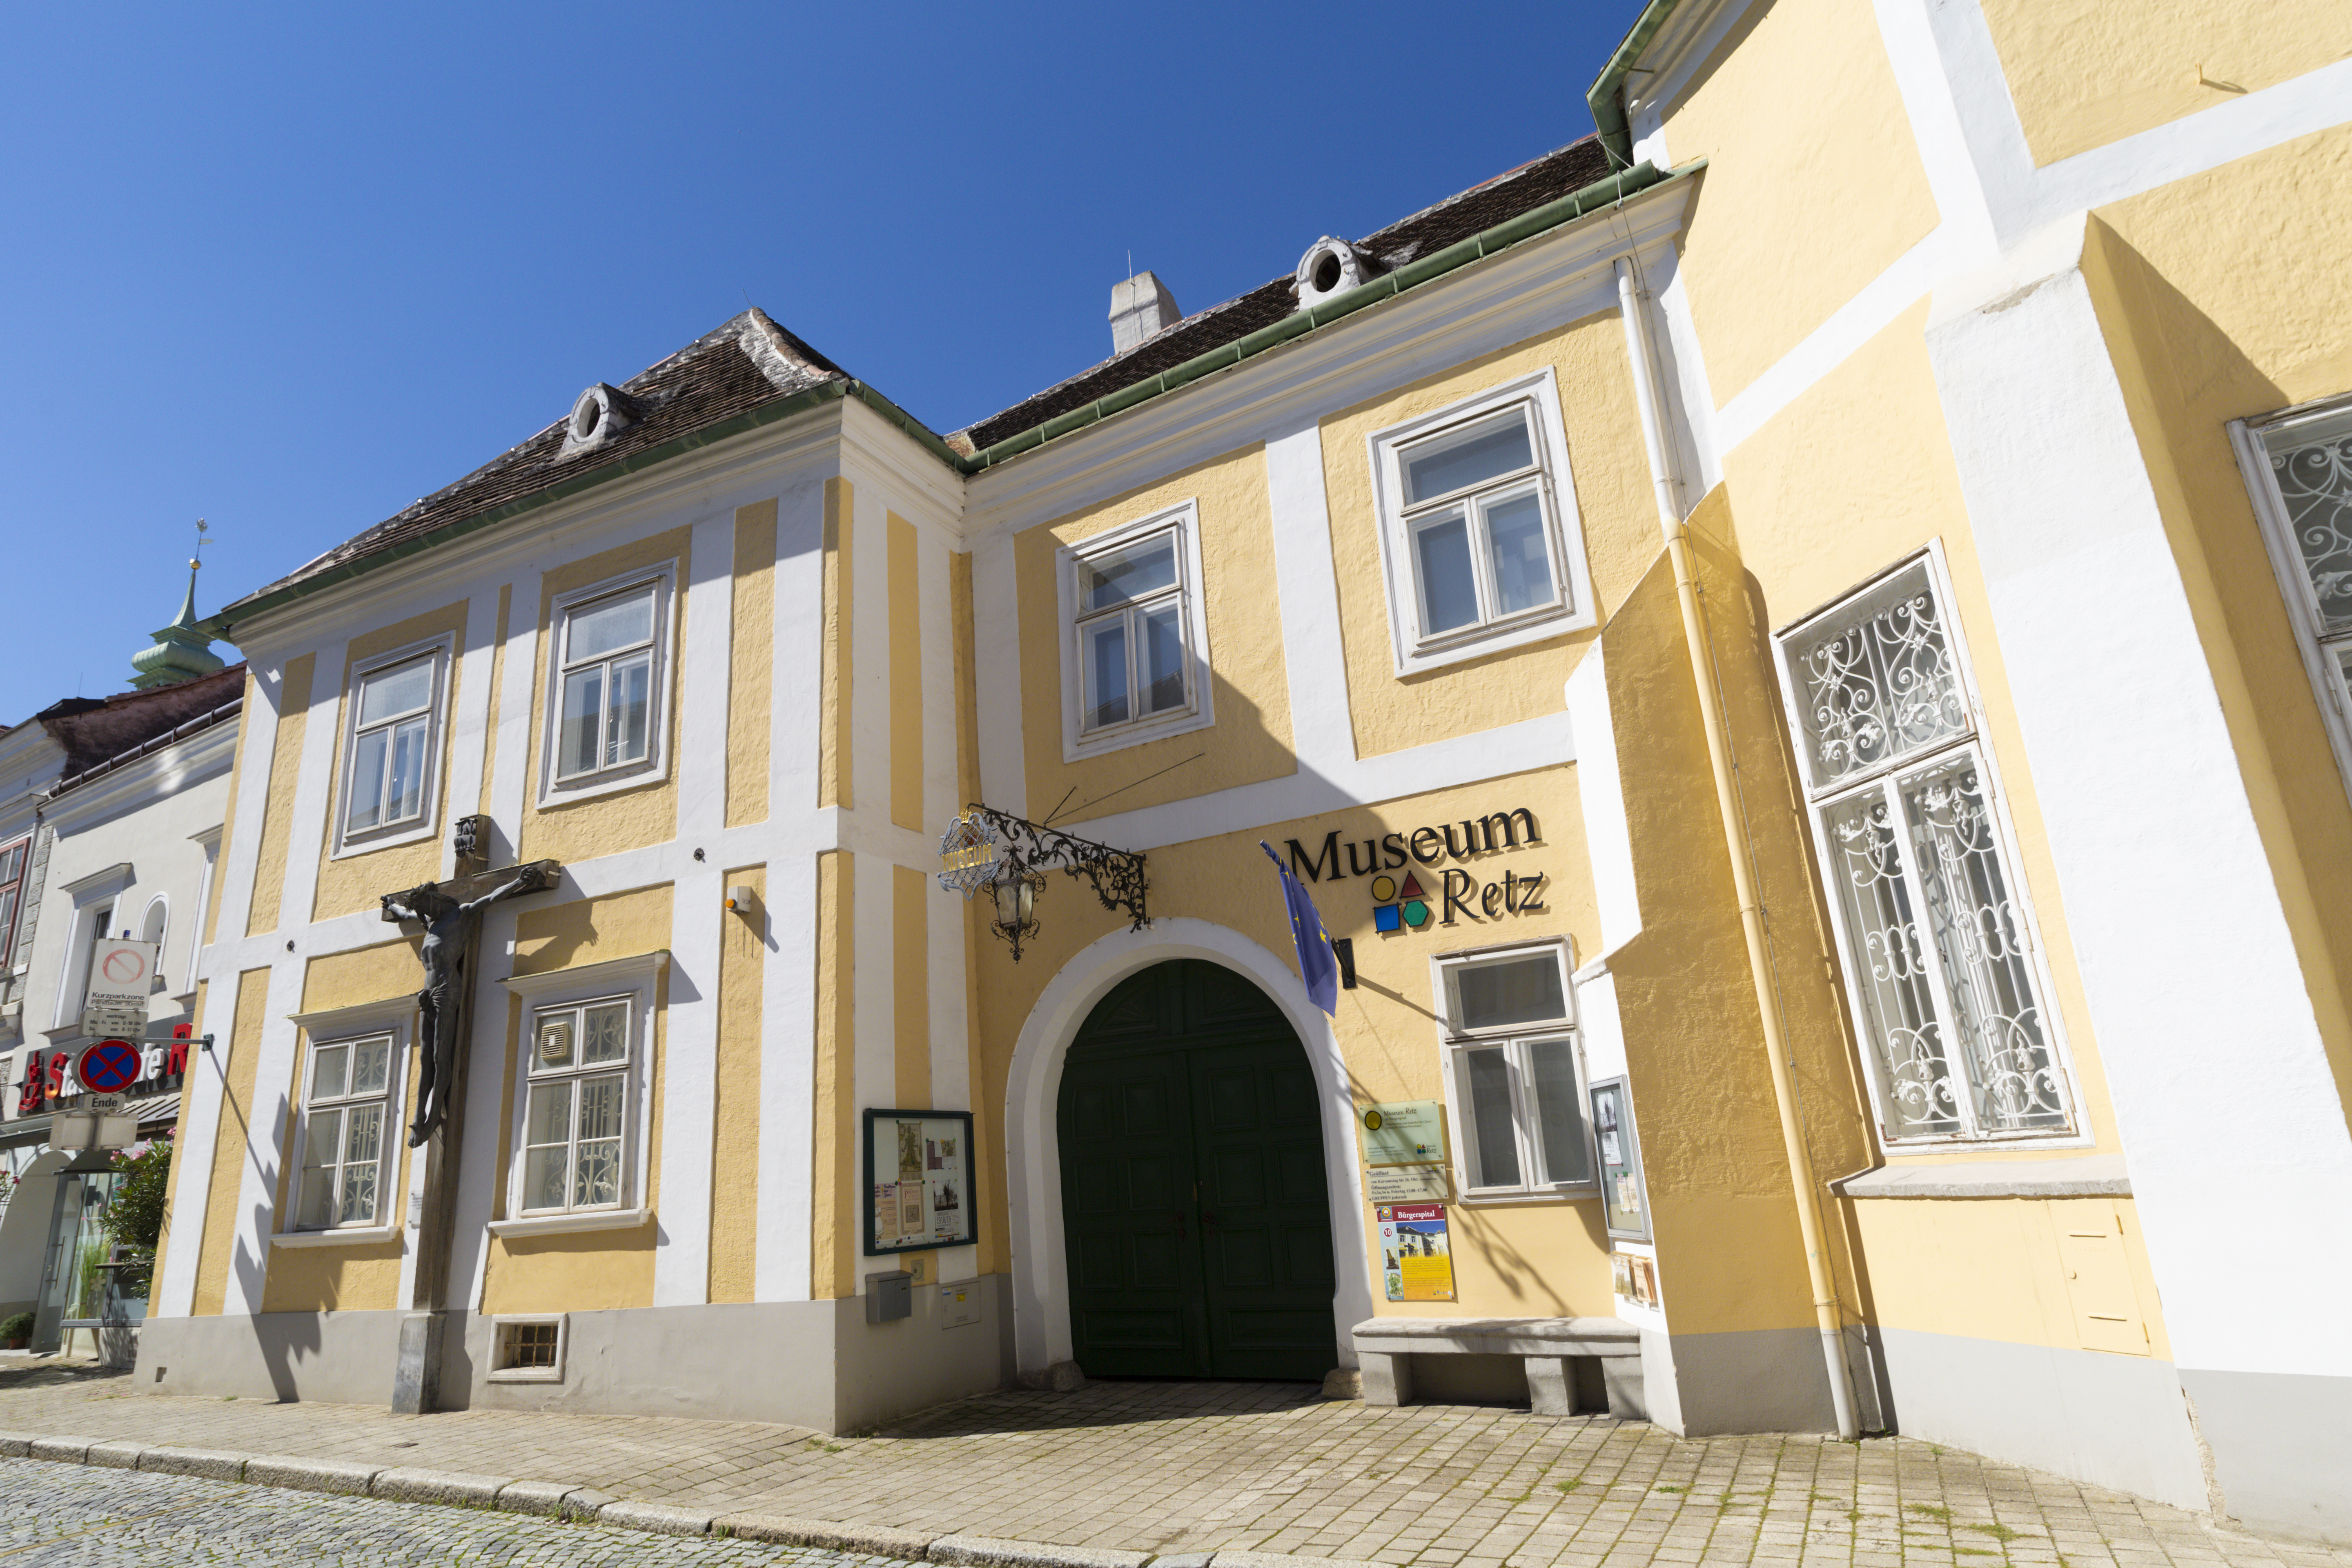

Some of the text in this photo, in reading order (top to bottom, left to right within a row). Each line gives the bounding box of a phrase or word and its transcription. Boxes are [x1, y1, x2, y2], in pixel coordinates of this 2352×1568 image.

[1283, 807, 1542, 885] Museum
[942, 843, 992, 873] MUSEUM
[1439, 868, 1544, 924] Retz
[92, 992, 145, 1000] Kurzparkzone
[91, 1098, 118, 1107] Ende
[937, 1215, 951, 1224] 1918/19
[1398, 1209, 1435, 1220] Bürgerspital
